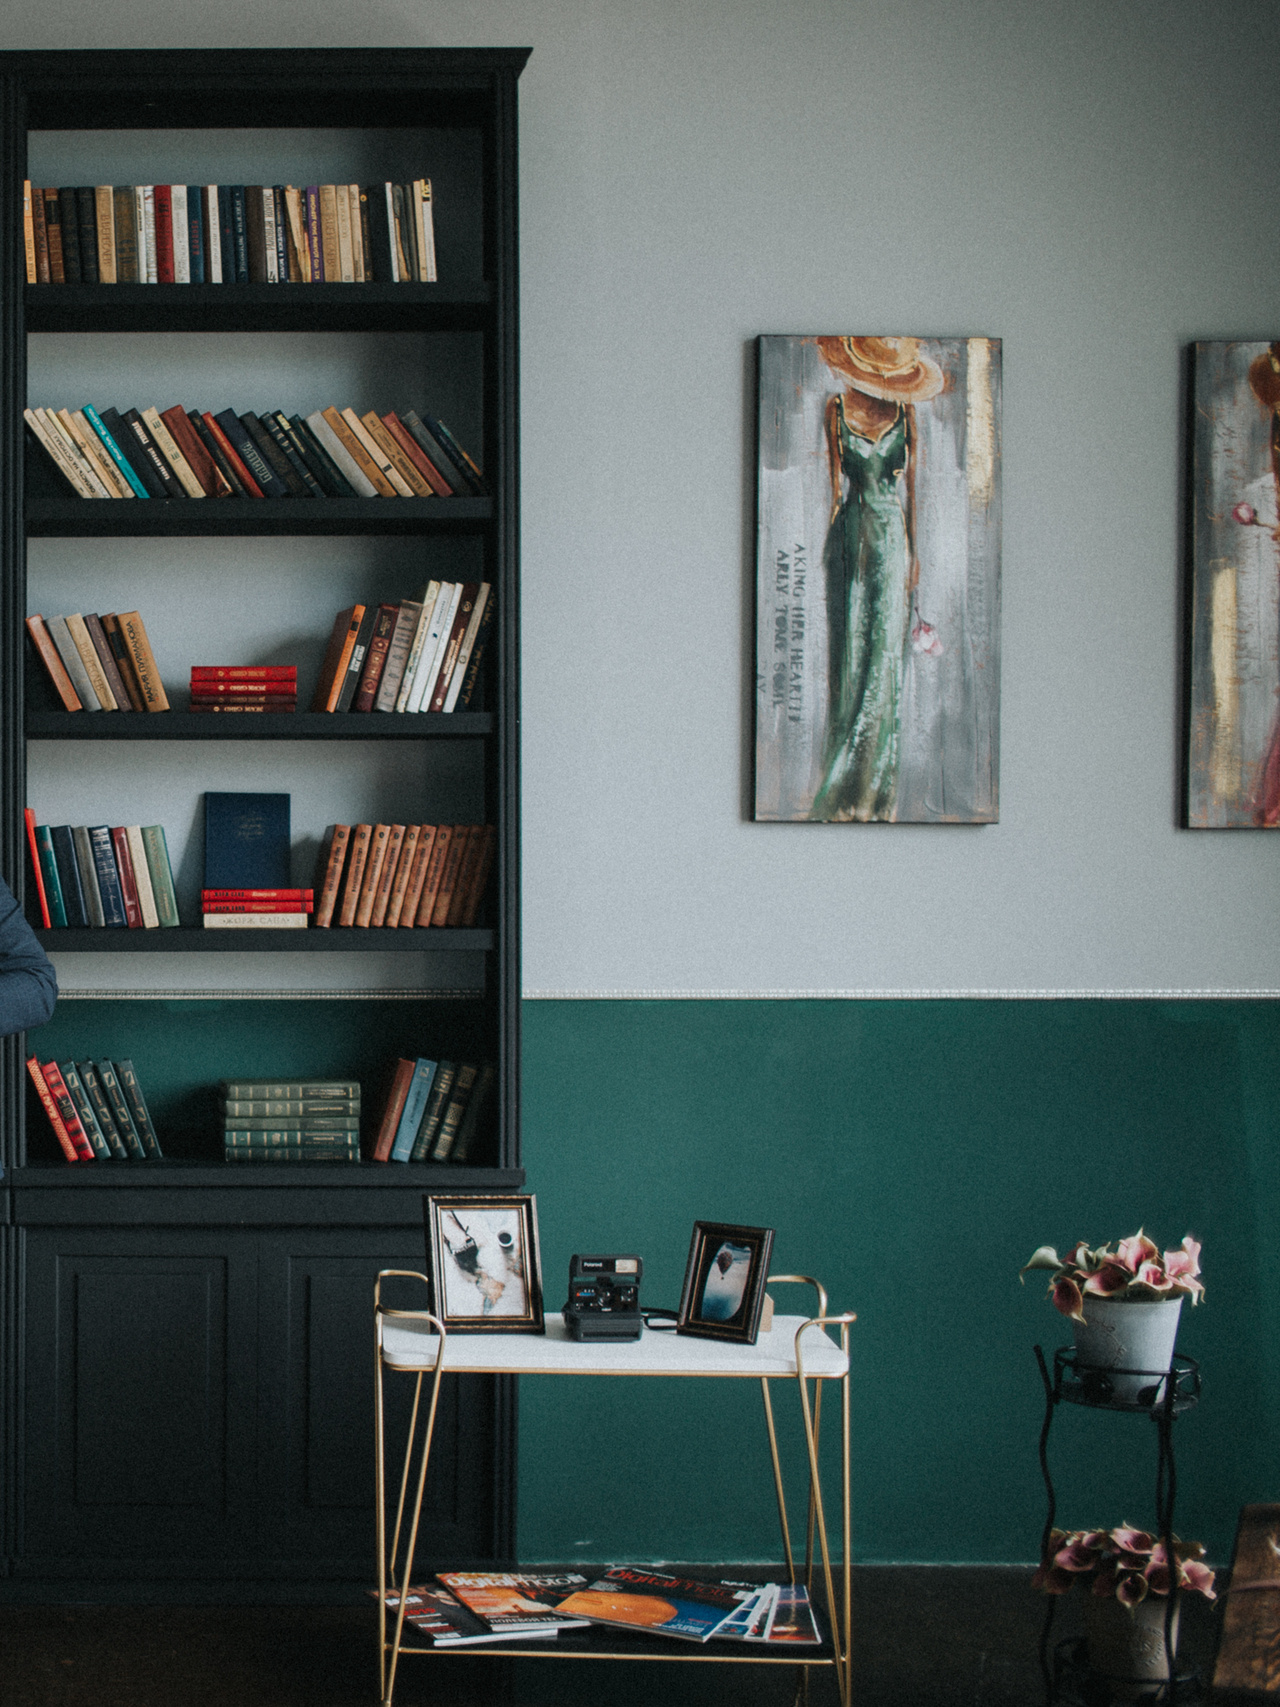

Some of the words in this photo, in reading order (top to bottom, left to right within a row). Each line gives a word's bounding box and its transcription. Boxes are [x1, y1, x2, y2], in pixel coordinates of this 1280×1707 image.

[70, 460, 80, 470] НА
[123, 619, 147, 673] ПУЙМАНОВА
[139, 672, 156, 703] МАРИЯ
[446, 1574, 571, 1588] DigitalPhoto
